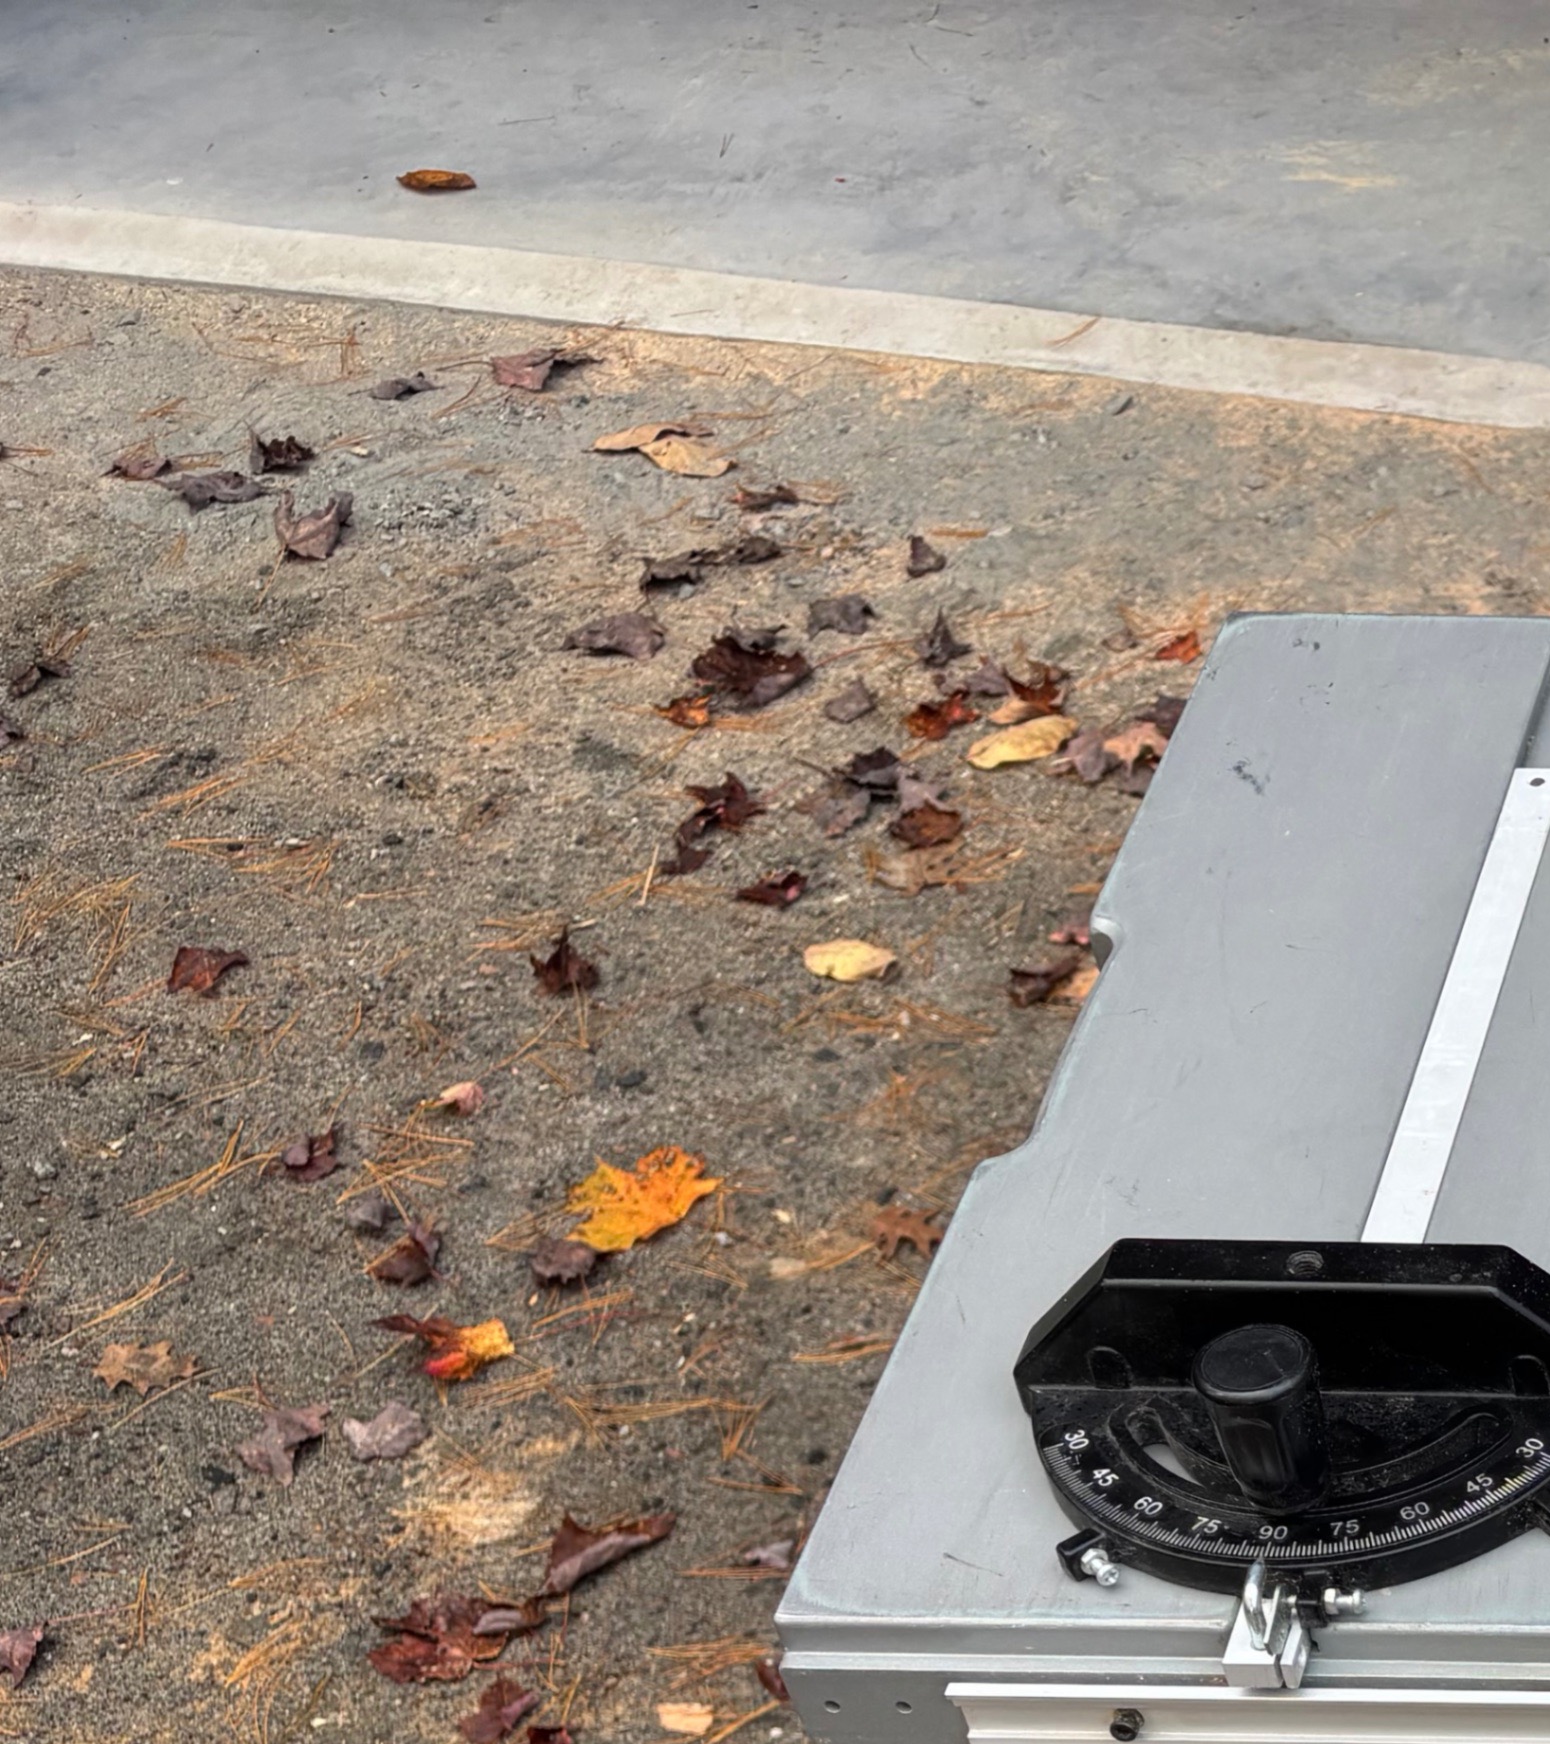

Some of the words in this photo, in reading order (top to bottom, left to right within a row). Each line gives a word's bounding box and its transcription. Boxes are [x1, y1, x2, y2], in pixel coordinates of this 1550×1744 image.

[1063, 1427, 1091, 1450] 30
[1091, 1466, 1118, 1489] 45
[1133, 1494, 1162, 1518] 60
[1190, 1516, 1220, 1535] 75
[1258, 1524, 1290, 1542] 90
[1330, 1518, 1361, 1536] 75
[1399, 1501, 1432, 1522] 60
[1465, 1471, 1494, 1495] 45
[1515, 1437, 1545, 1460] 30
